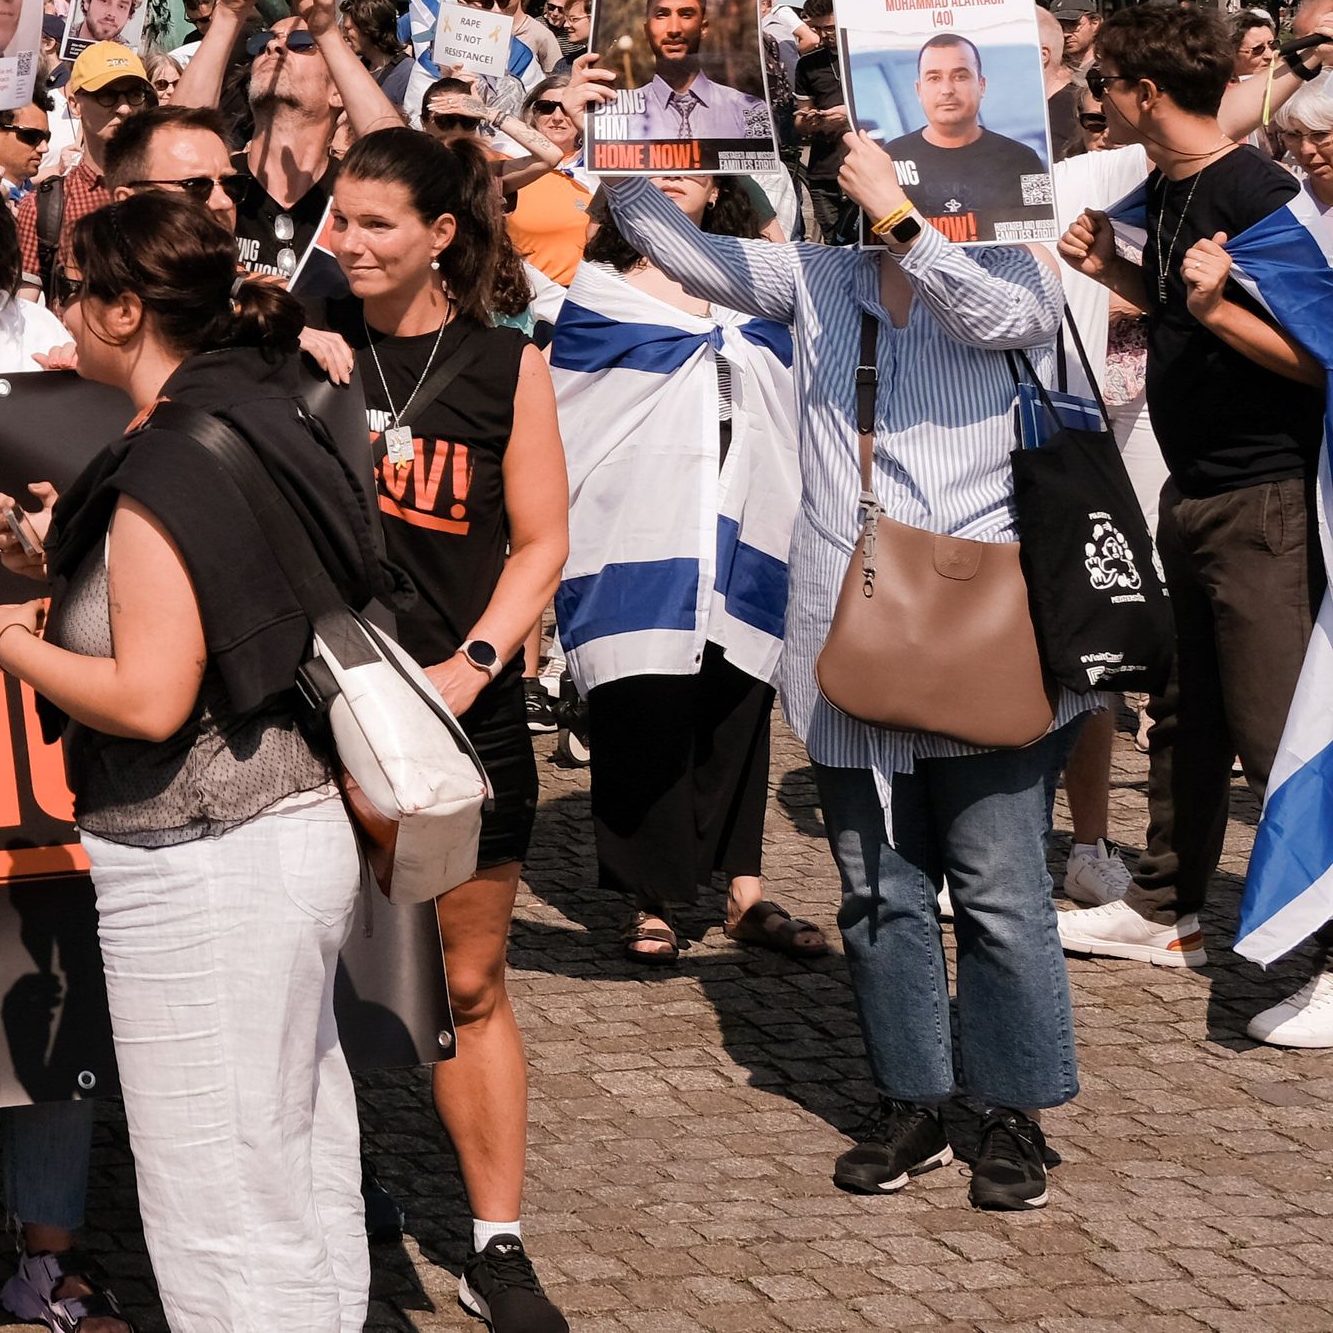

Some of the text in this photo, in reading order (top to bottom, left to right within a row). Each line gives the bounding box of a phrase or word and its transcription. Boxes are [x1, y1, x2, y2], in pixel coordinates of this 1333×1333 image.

[460, 17, 482, 29] RAPE
[932, 9, 954, 27] (40)
[456, 33, 482, 45] IS NOT
[444, 46, 494, 64] RESISTANCE!
[594, 116, 628, 140] HIM
[595, 141, 702, 169] HOME NOW!
